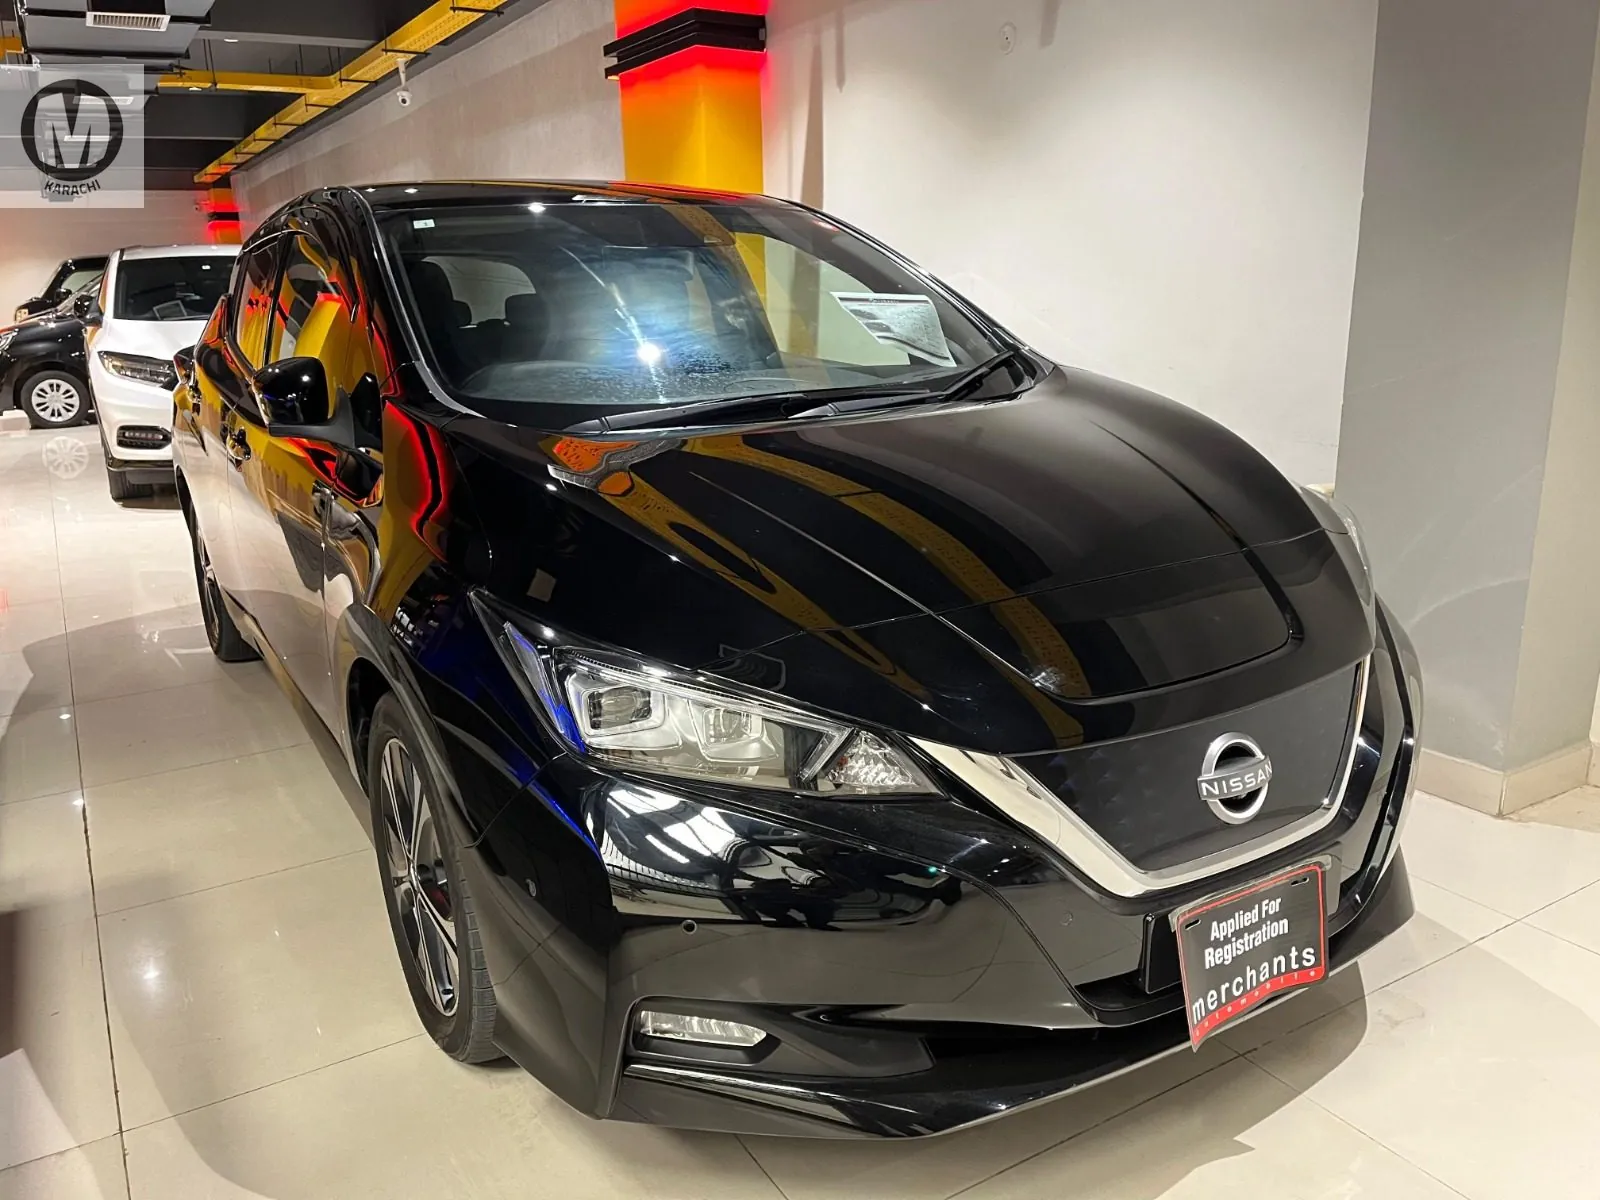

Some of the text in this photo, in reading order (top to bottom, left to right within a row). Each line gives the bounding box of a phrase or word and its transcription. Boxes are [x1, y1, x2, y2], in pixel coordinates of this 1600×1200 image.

[1201, 760, 1272, 796] NISSAN
[1210, 897, 1282, 942] Applied For
[1204, 918, 1289, 970] Registration
[1192, 946, 1316, 1025] merchants
